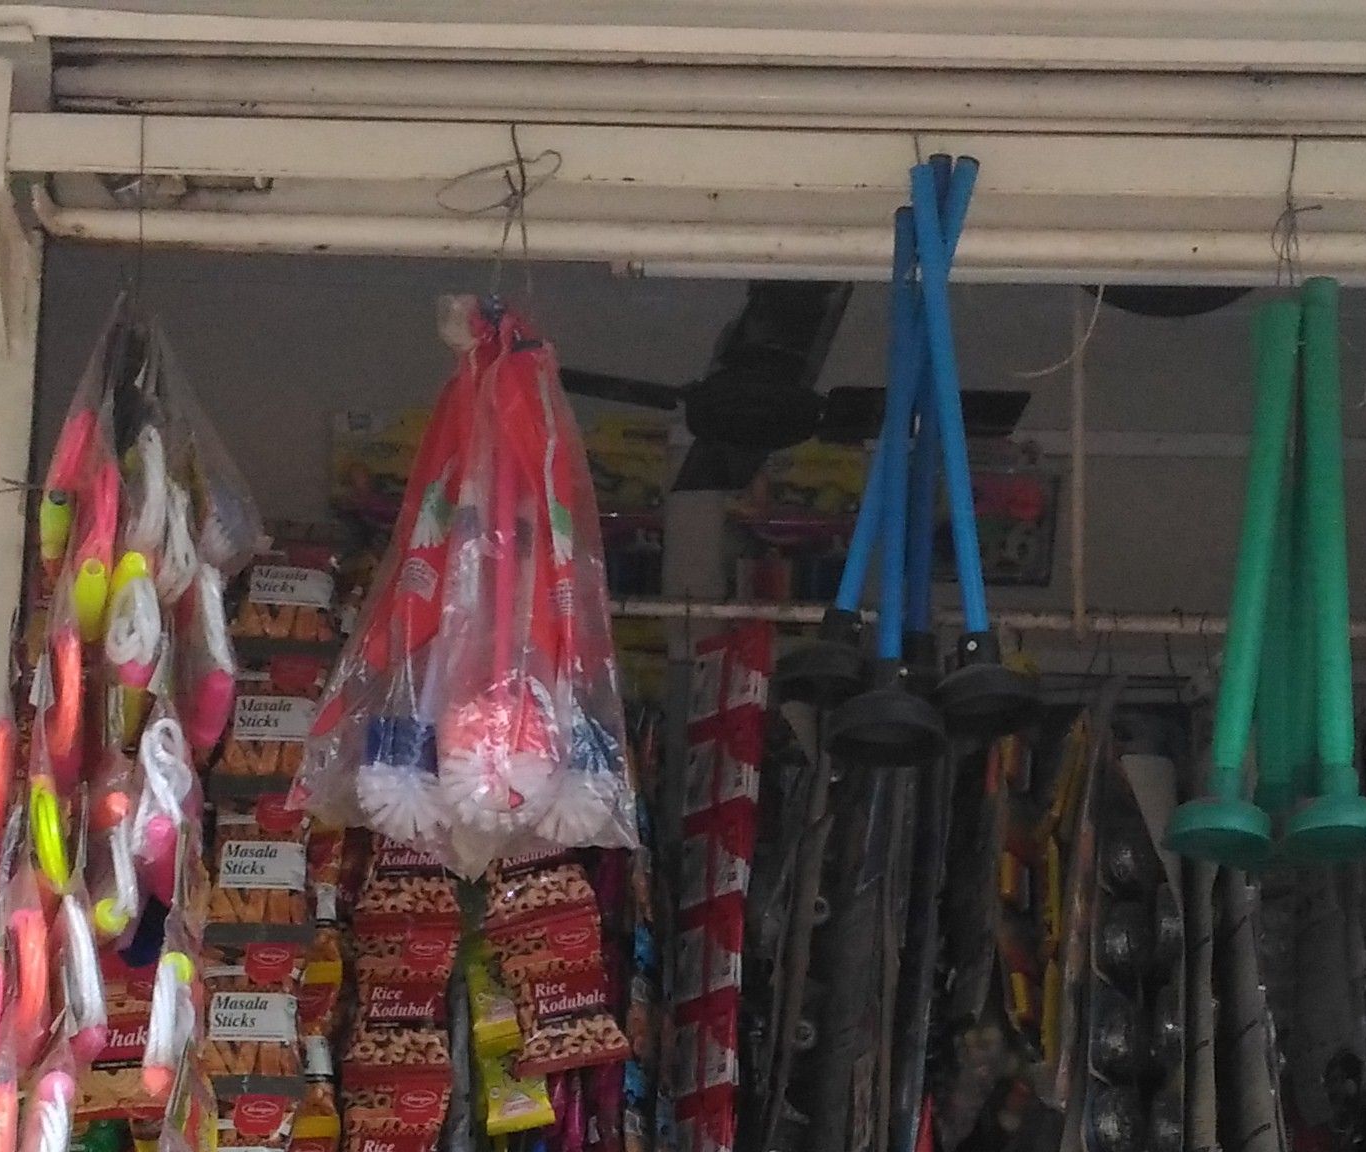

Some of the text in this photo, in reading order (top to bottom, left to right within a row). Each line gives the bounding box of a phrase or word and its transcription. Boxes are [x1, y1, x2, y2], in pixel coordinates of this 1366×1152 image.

[257, 566, 309, 582] Masala
[254, 580, 295, 594] Sticks
[237, 698, 292, 712] Masala
[236, 713, 279, 728] Sticks
[224, 843, 278, 858] Masala
[382, 850, 438, 866] Koduba
[223, 860, 266, 876] Sticks
[371, 986, 403, 1001] Rice
[535, 982, 566, 998] Rice
[213, 994, 268, 1010] Masala
[369, 1001, 435, 1018] Kodubale
[538, 990, 606, 1015] Kodubale
[213, 1012, 256, 1028] Sticks
